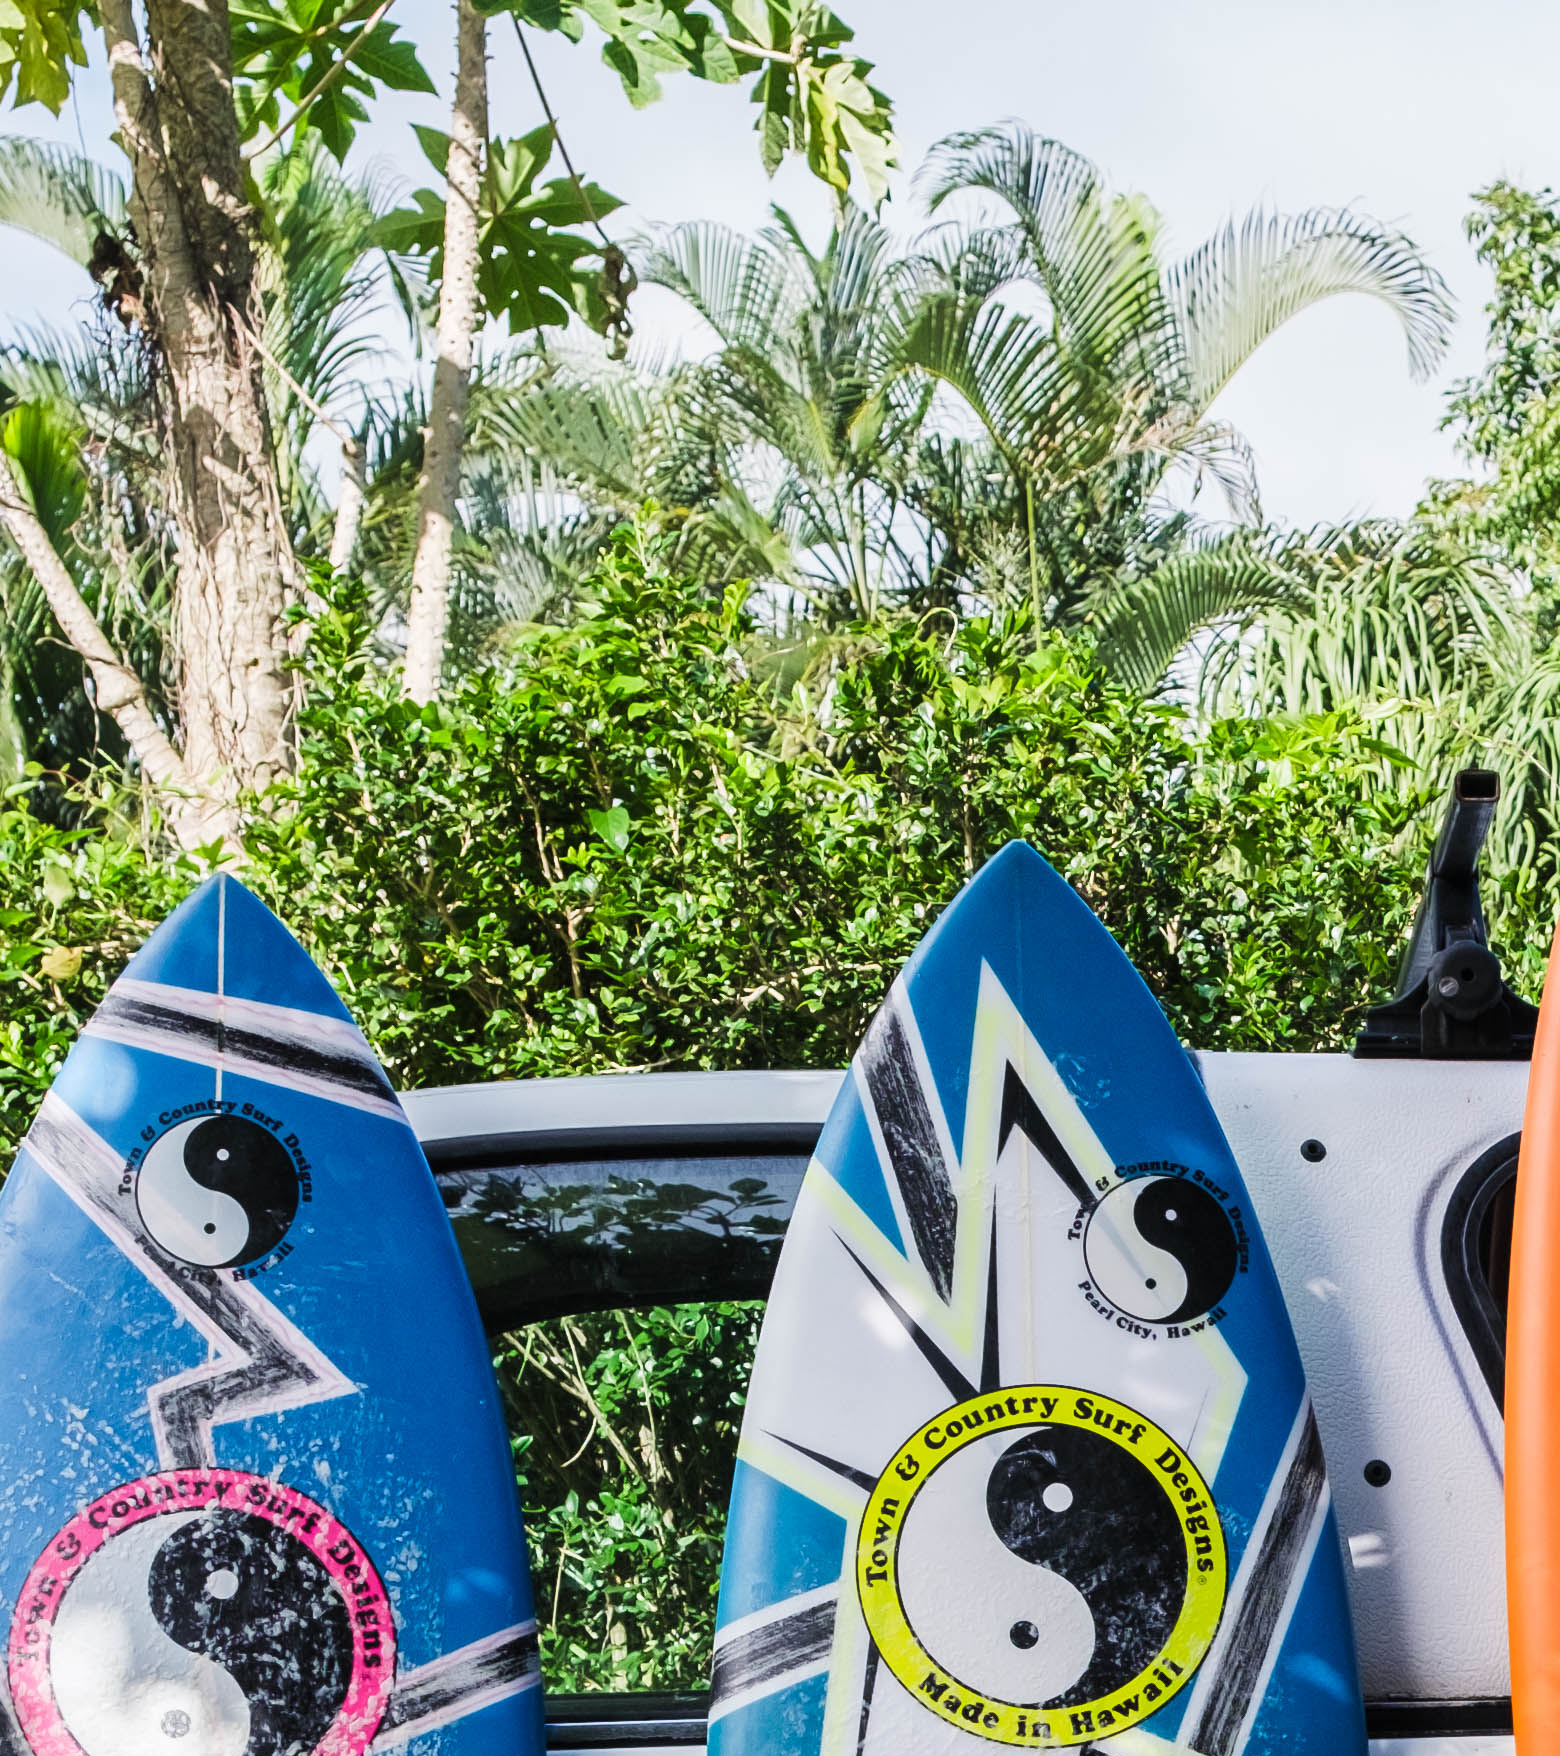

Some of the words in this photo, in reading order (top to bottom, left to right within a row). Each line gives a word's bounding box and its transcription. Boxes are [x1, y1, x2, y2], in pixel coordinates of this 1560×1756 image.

[118, 1147, 143, 1196] Town
[141, 1126, 156, 1141] &
[159, 1099, 237, 1125] Country
[241, 1103, 283, 1131] Surf
[283, 1133, 312, 1202] Designs
[1095, 1176, 1110, 1191] &
[1114, 1159, 1189, 1178] Country
[1192, 1170, 1230, 1201] Surf
[1228, 1205, 1250, 1274] Designs
[1078, 1280, 1115, 1321] Pearl
[1116, 1316, 1158, 1340] City,
[1167, 1307, 1228, 1339] Hawaii
[866, 1496, 900, 1588] Town
[895, 1453, 920, 1483] &
[923, 1396, 1060, 1451] Country
[1072, 1397, 1148, 1446] Surf
[1154, 1447, 1214, 1574] Designs
[56, 1533, 82, 1561] &
[88, 1479, 232, 1531] Country
[245, 1482, 323, 1535] Surf
[327, 1538, 382, 1669] Designs
[918, 1671, 1000, 1729] Made
[1015, 1714, 1052, 1739] in
[1069, 1657, 1185, 1736] Hawaii
